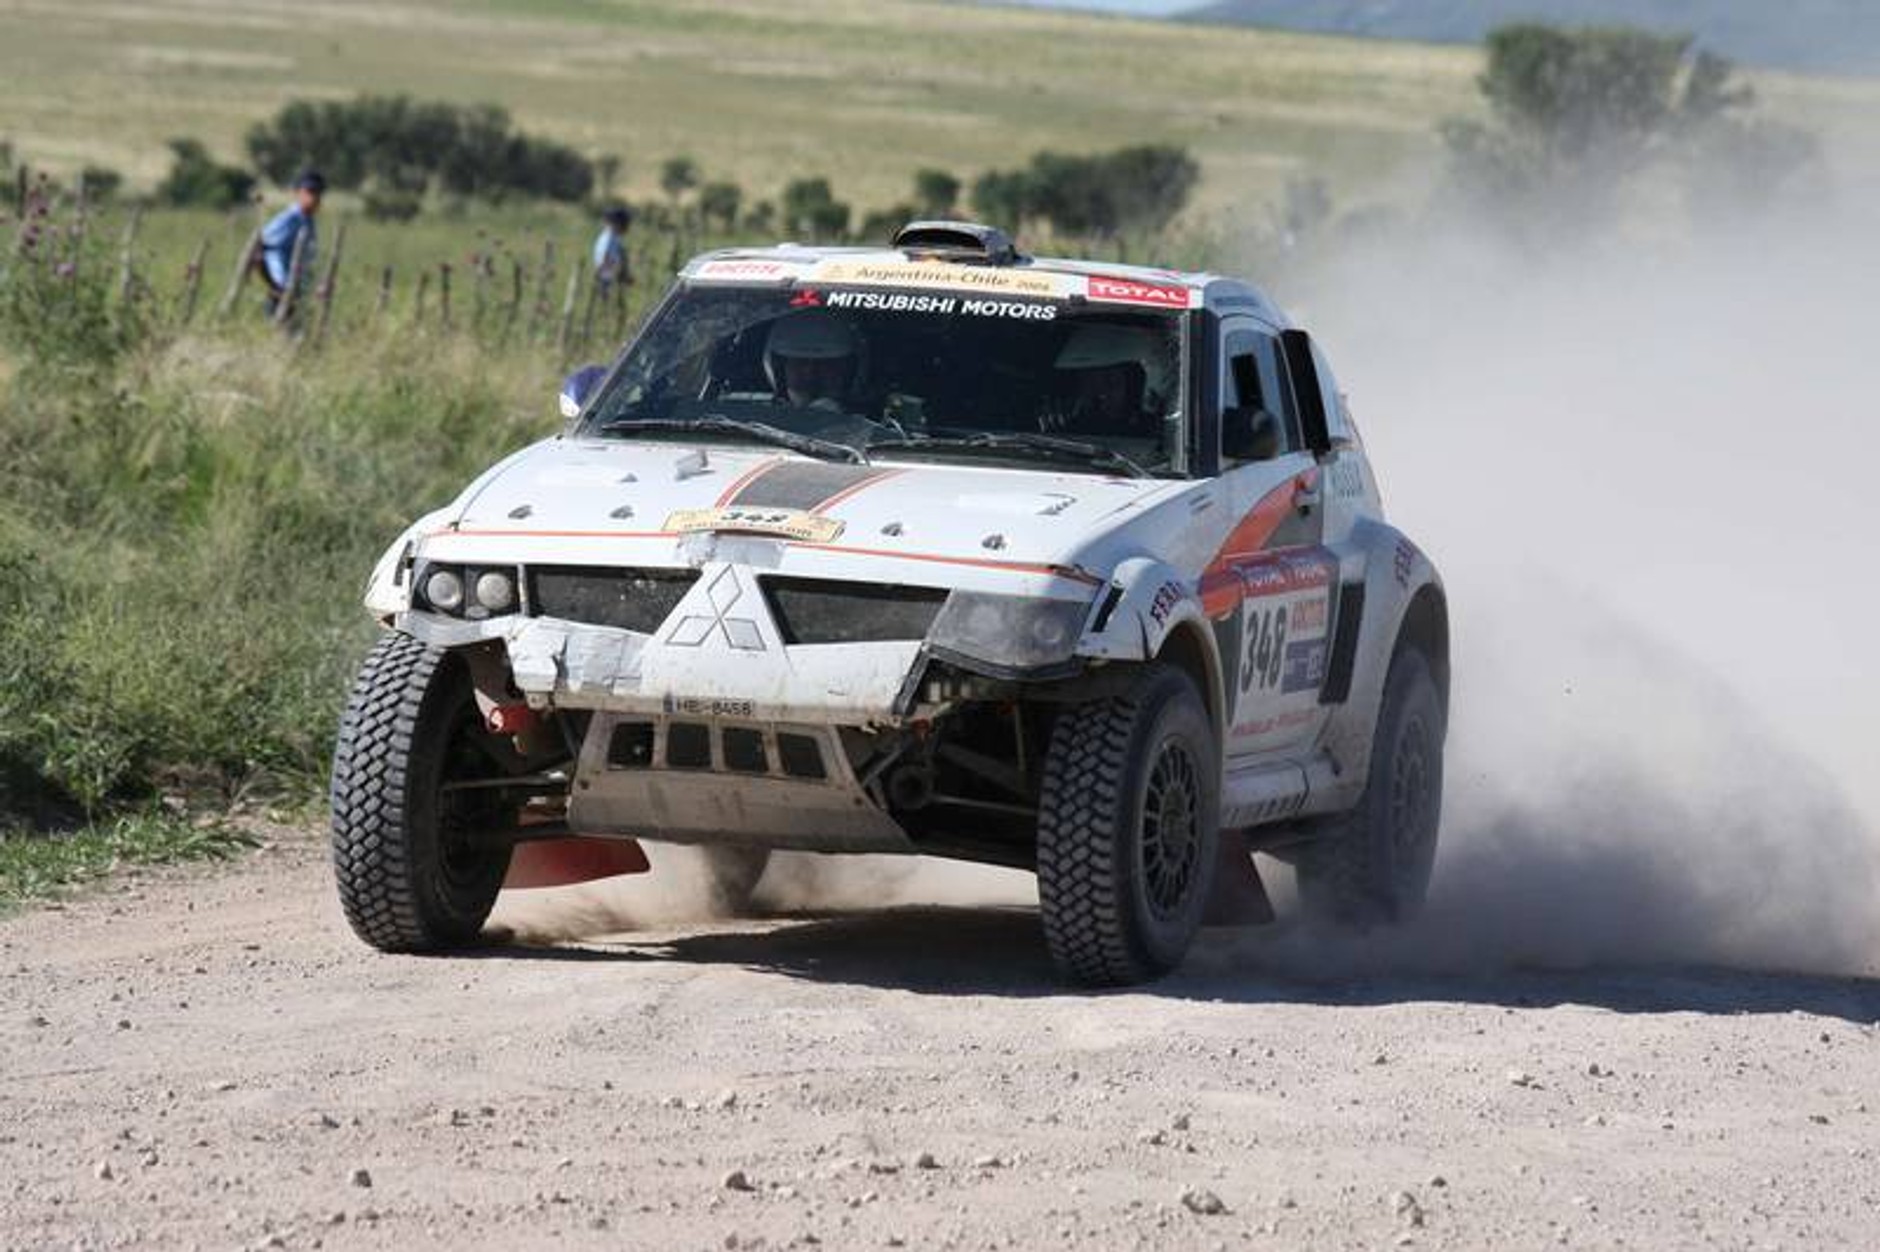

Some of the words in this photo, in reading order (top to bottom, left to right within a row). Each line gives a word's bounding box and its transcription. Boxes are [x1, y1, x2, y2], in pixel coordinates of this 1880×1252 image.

[1089, 282, 1186, 302] TOTAL
[827, 291, 955, 313] MITSUBISHI
[961, 300, 1058, 321] MOTORS
[720, 511, 788, 523] 348
[1241, 605, 1287, 693] 348
